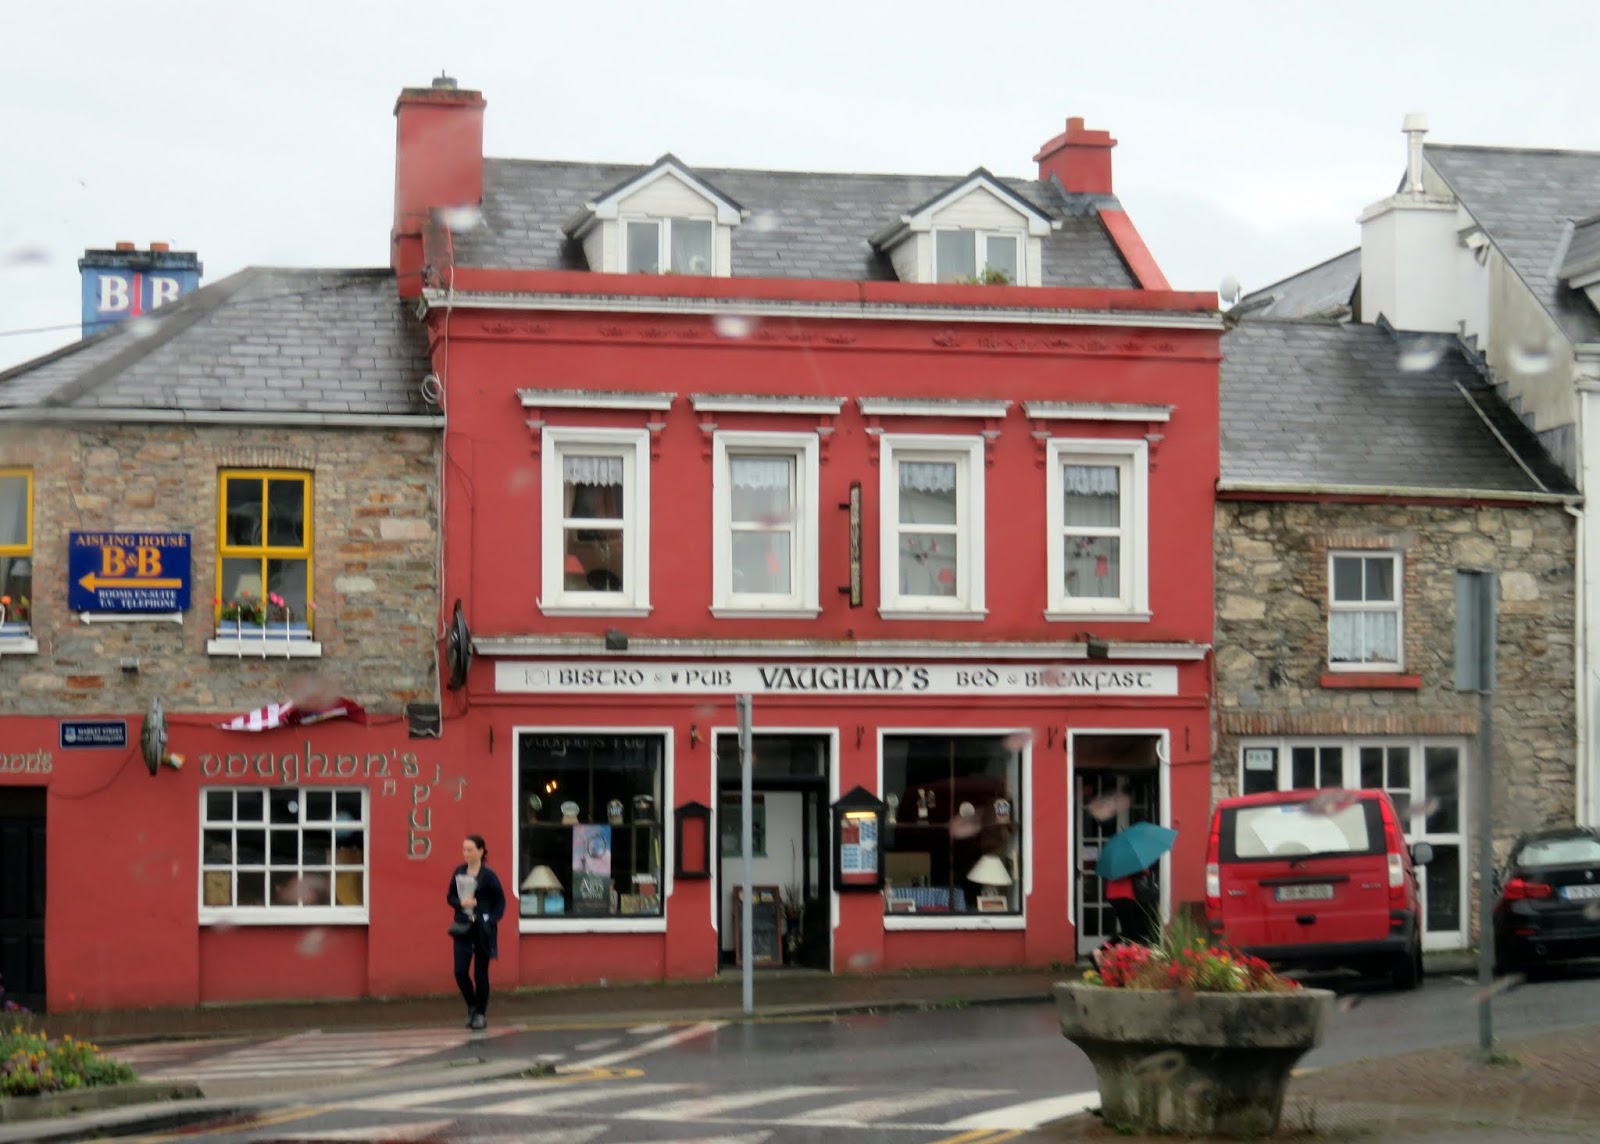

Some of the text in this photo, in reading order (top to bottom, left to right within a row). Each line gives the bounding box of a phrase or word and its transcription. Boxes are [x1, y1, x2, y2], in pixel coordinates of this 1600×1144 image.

[77, 534, 187, 547] AISLING HOUSE
[99, 545, 163, 577] B&B
[558, 667, 645, 687] BISTRO
[685, 669, 733, 687] PUB
[757, 664, 931, 692] VAUGHAN'S
